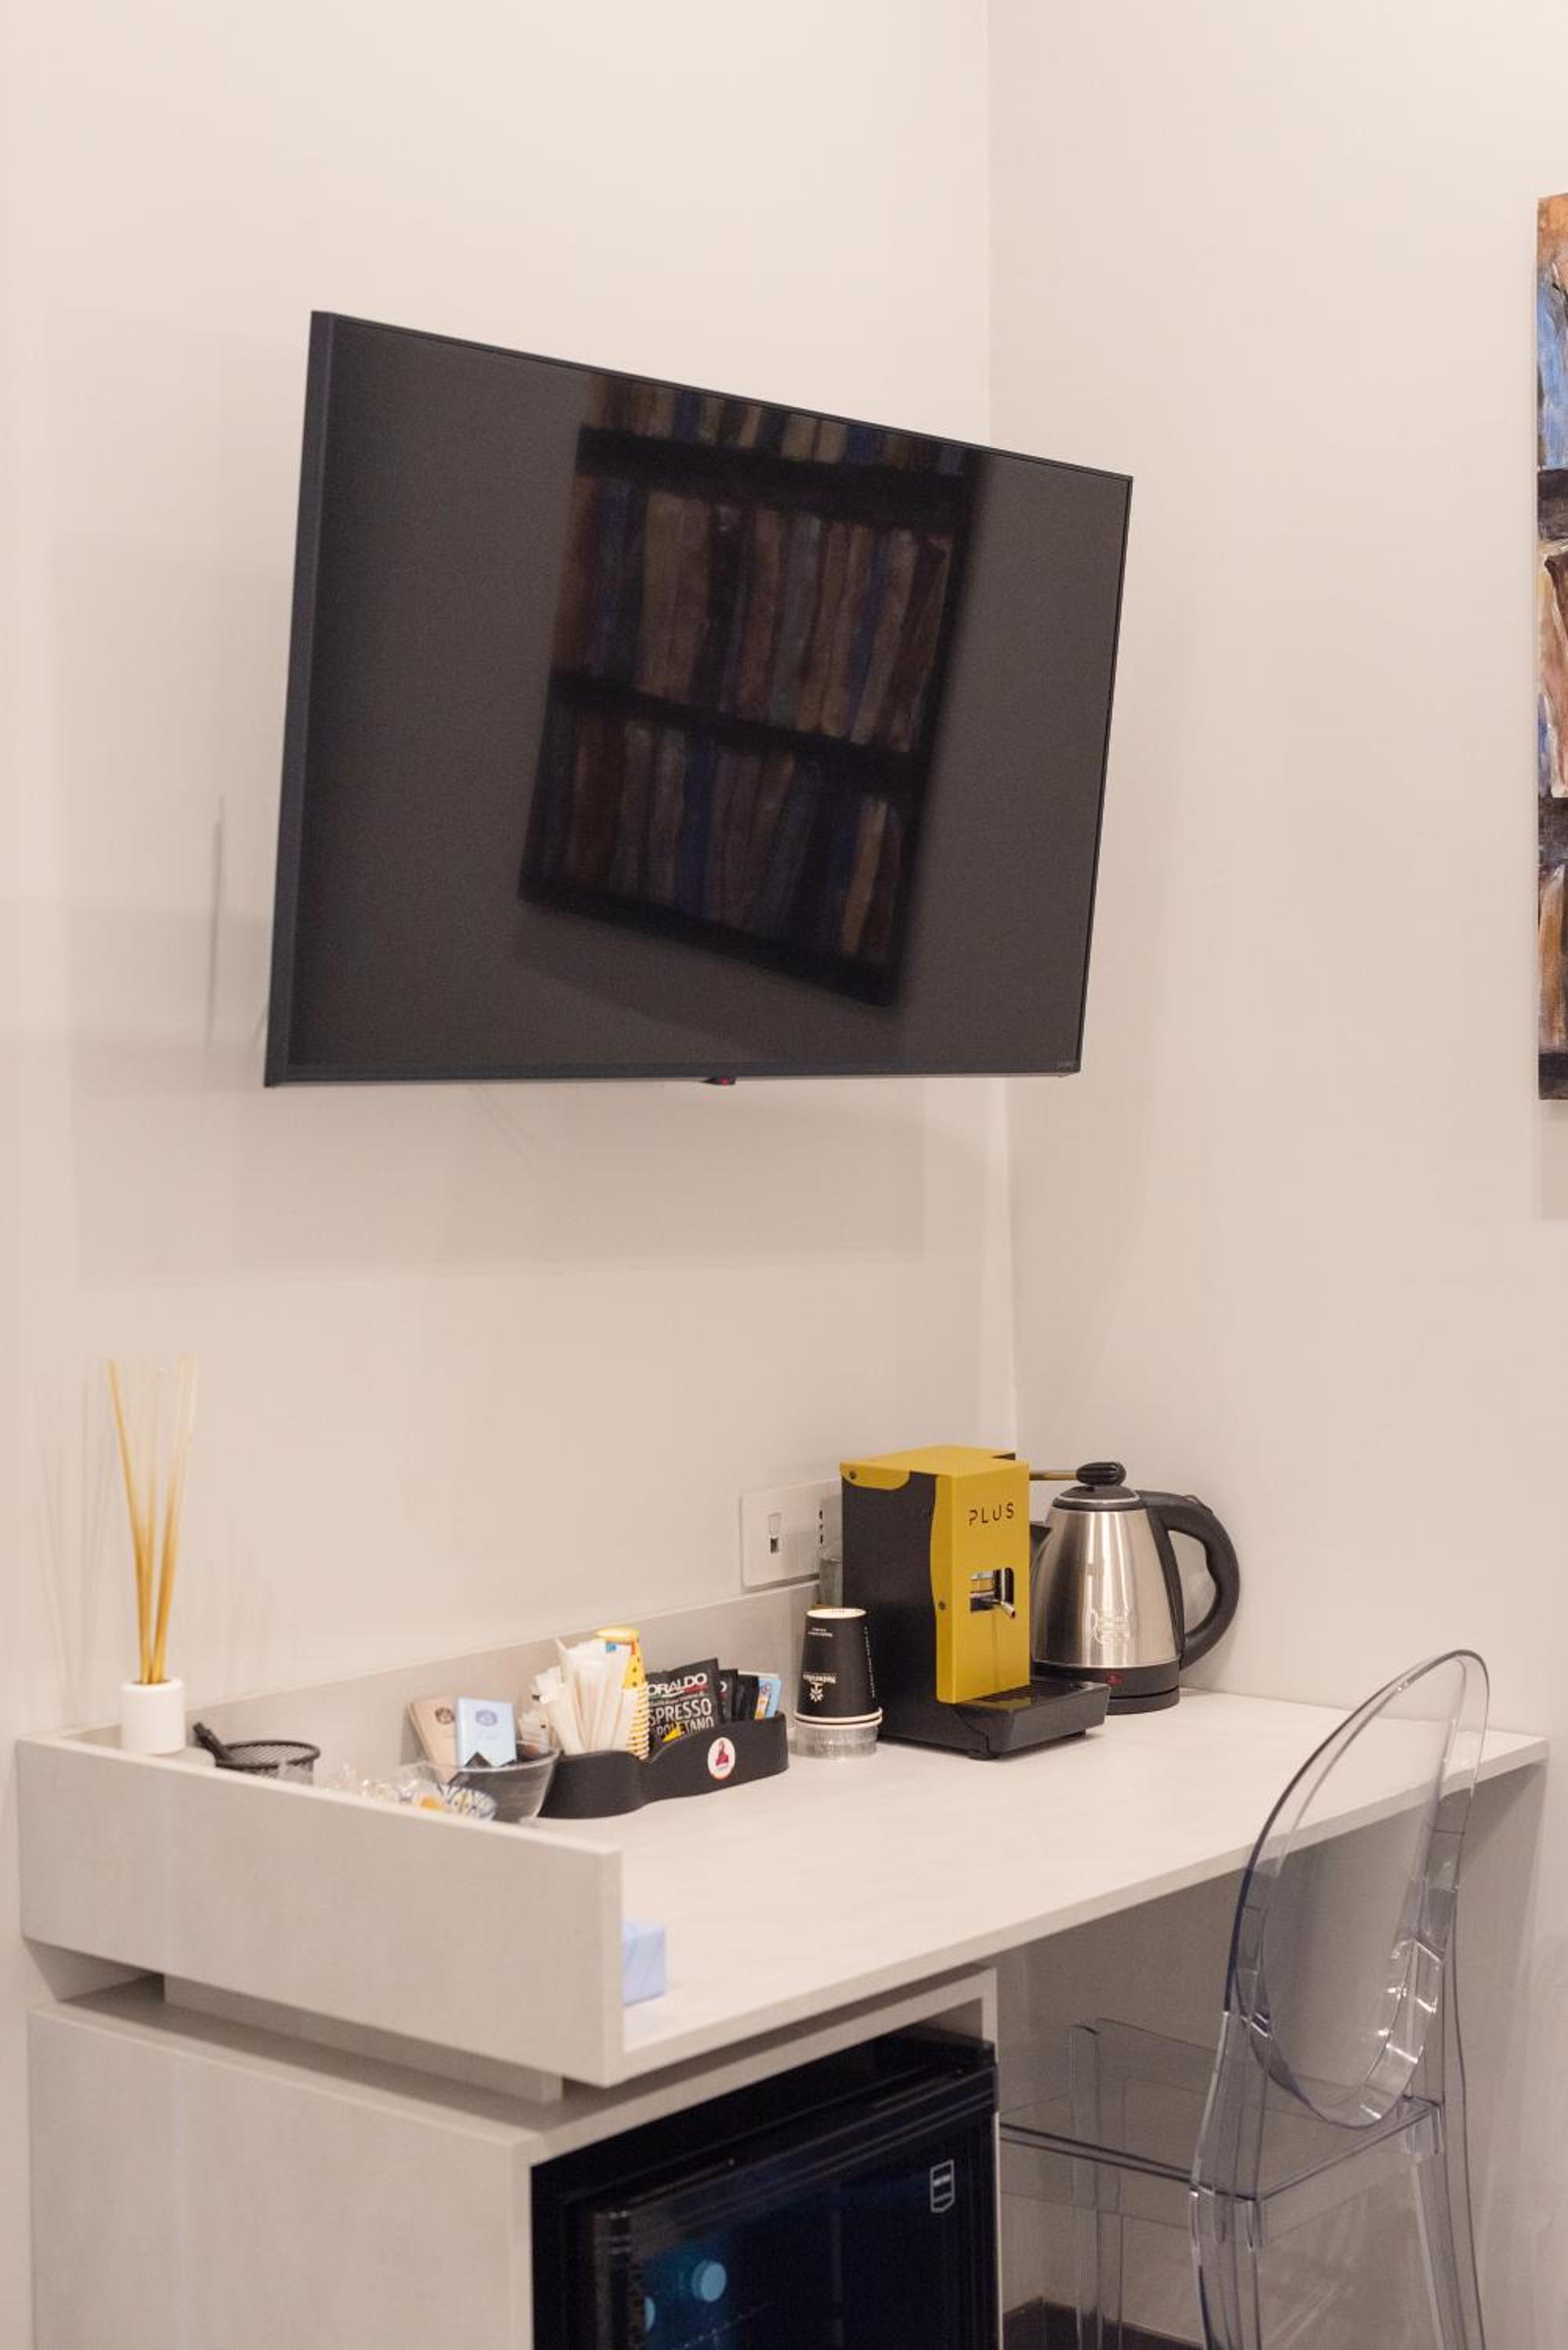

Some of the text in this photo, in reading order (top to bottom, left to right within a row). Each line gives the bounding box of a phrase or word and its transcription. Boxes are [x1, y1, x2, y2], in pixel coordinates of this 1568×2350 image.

[969, 1501, 1014, 1526] PLUS
[648, 1672, 707, 1695] ORALDO
[649, 1697, 712, 1726] SPRESSO
